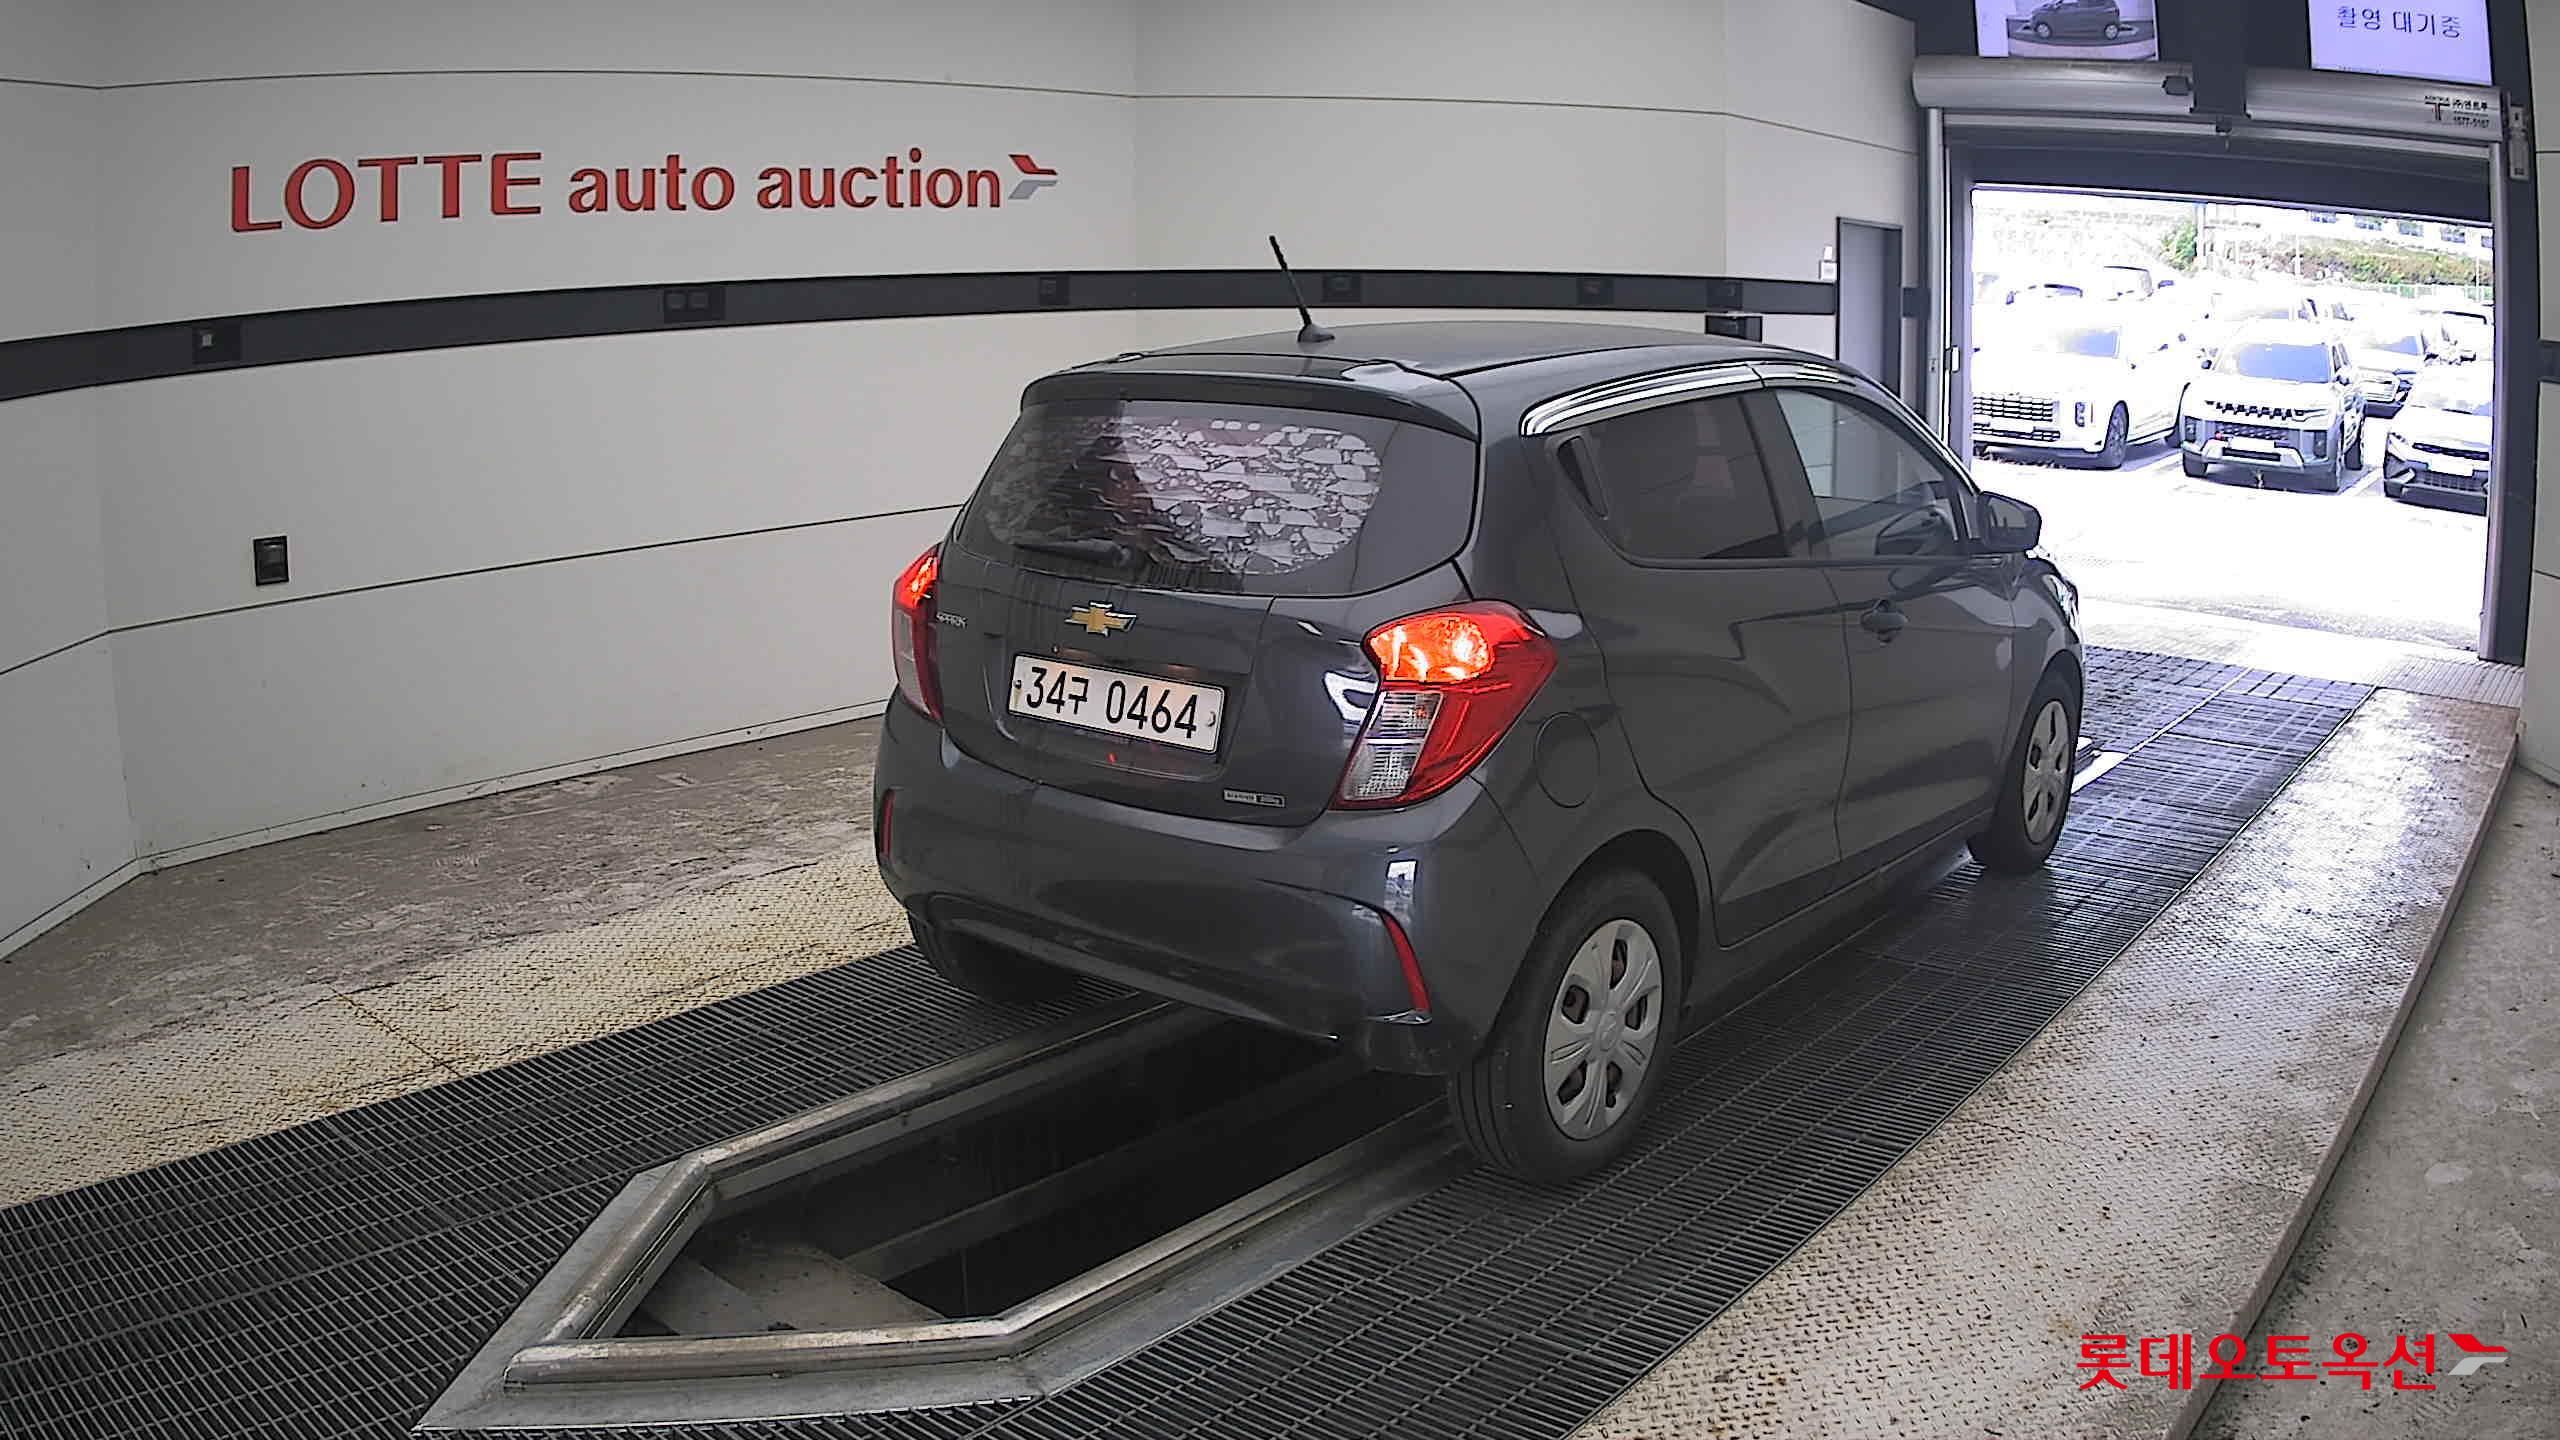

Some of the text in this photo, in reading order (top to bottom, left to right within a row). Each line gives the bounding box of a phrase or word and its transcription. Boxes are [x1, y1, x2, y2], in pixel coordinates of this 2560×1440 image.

[2337, 6, 2461, 39] 촬영 대기중
[230, 147, 1002, 233] LOTTE auto auction
[1025, 666, 1199, 739] 34구 0464
